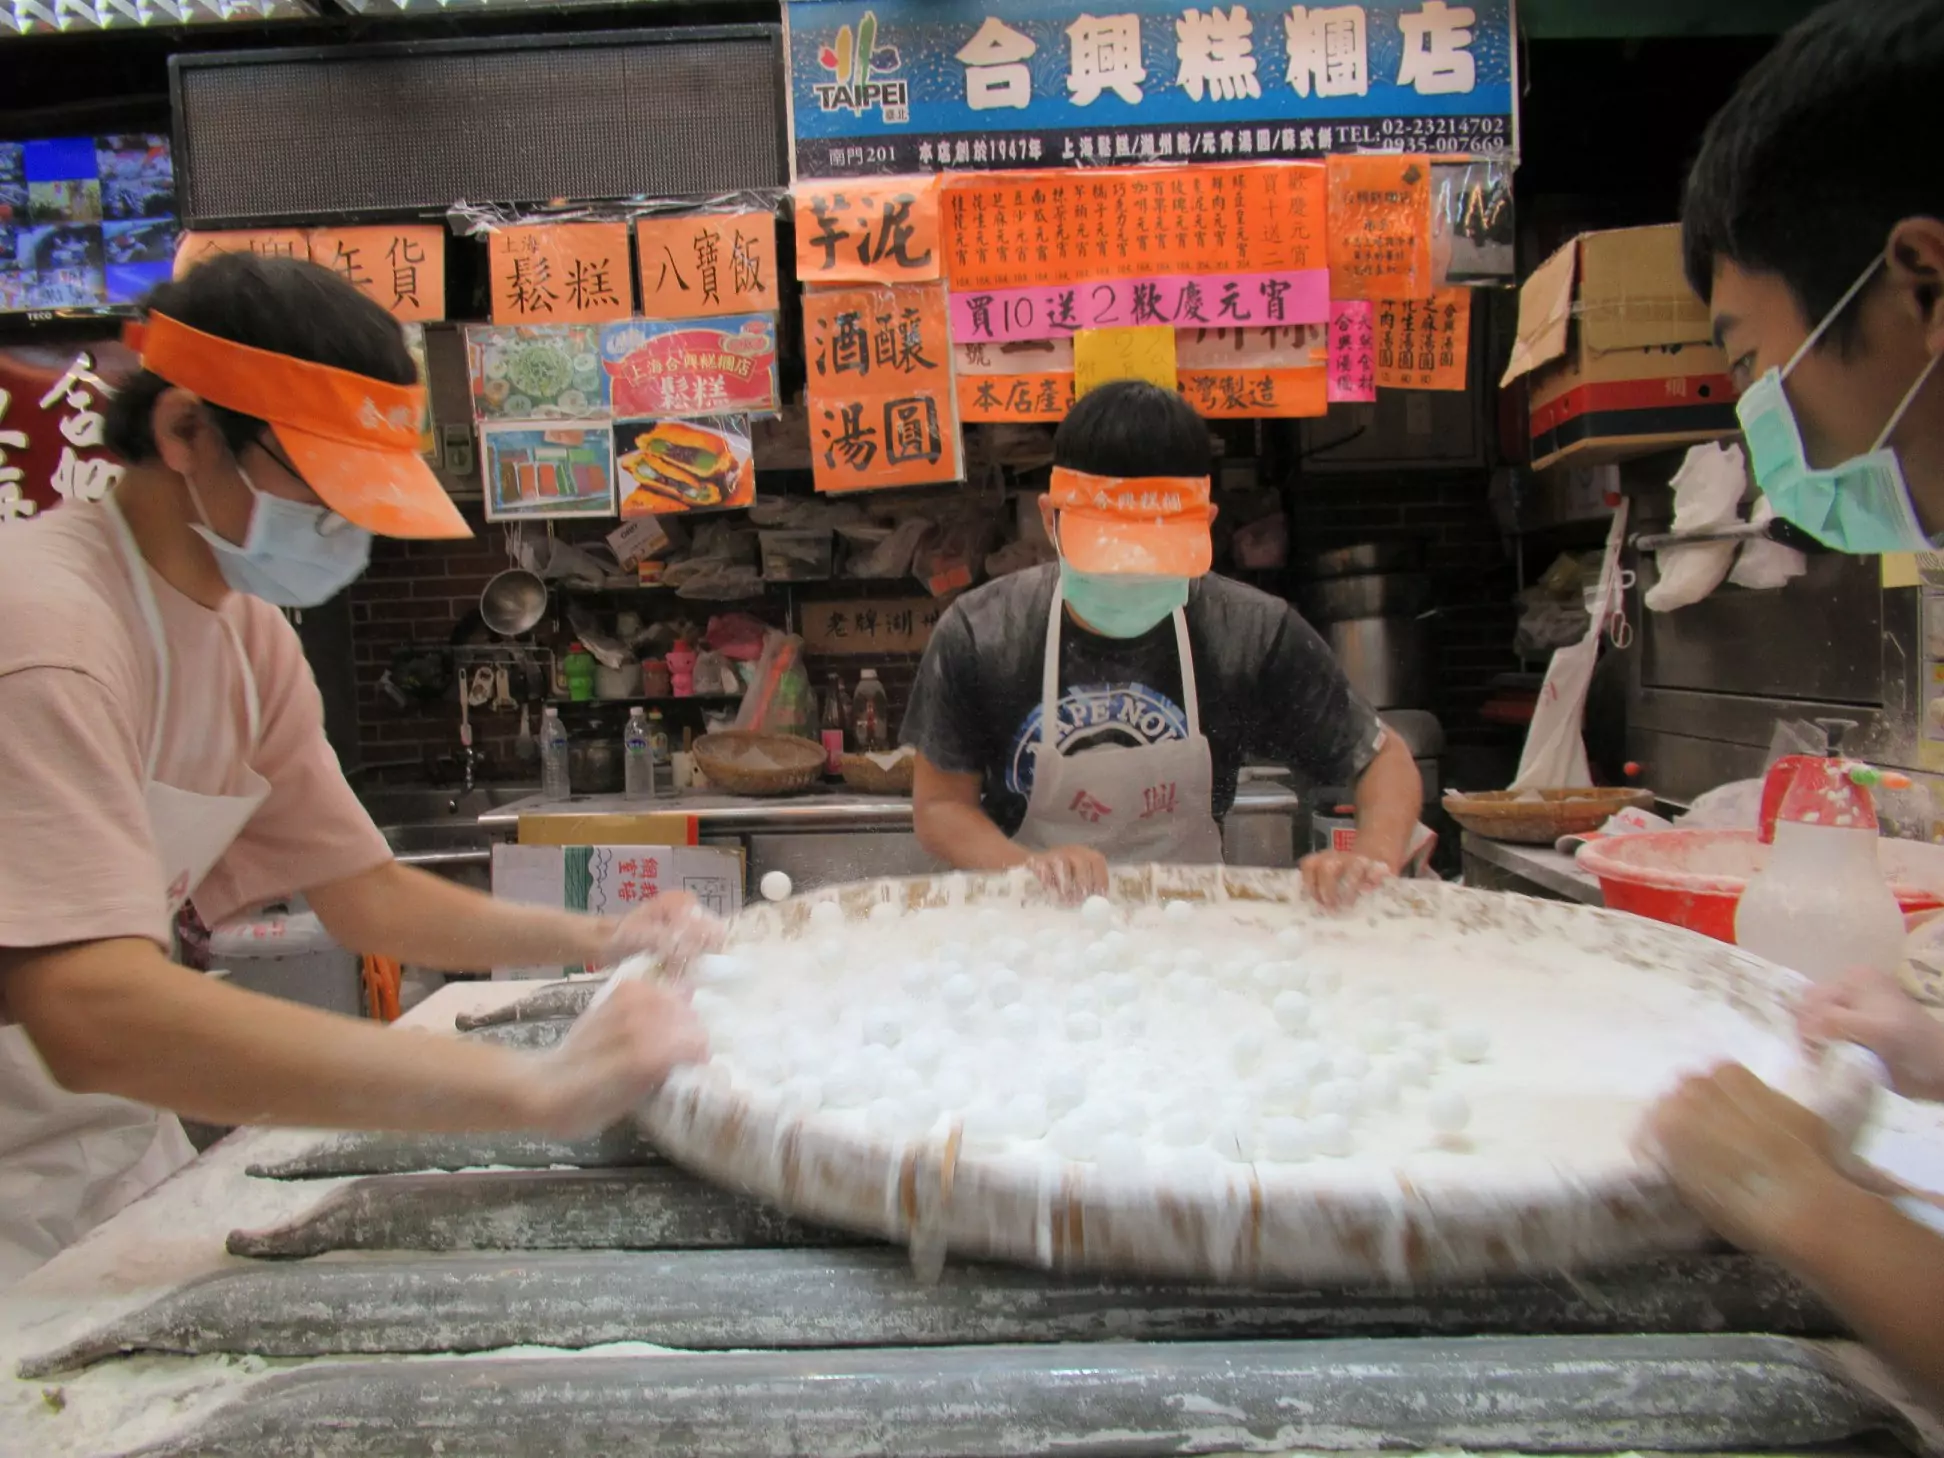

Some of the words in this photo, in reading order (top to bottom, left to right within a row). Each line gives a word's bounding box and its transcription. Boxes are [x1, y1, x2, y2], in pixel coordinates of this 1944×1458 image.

[814, 81, 907, 111] TAIPEI
[1382, 118, 1504, 135] 02-23214702
[501, 234, 539, 254] 上海
[655, 227, 767, 306] 八寶飯
[506, 256, 620, 314] 鬆糕
[27, 311, 52, 321] TECO
[815, 308, 938, 377] 酒釀
[661, 374, 729, 410] 鬆糕
[1177, 374, 1281, 411] 灣製造
[822, 396, 942, 472] 湯圓
